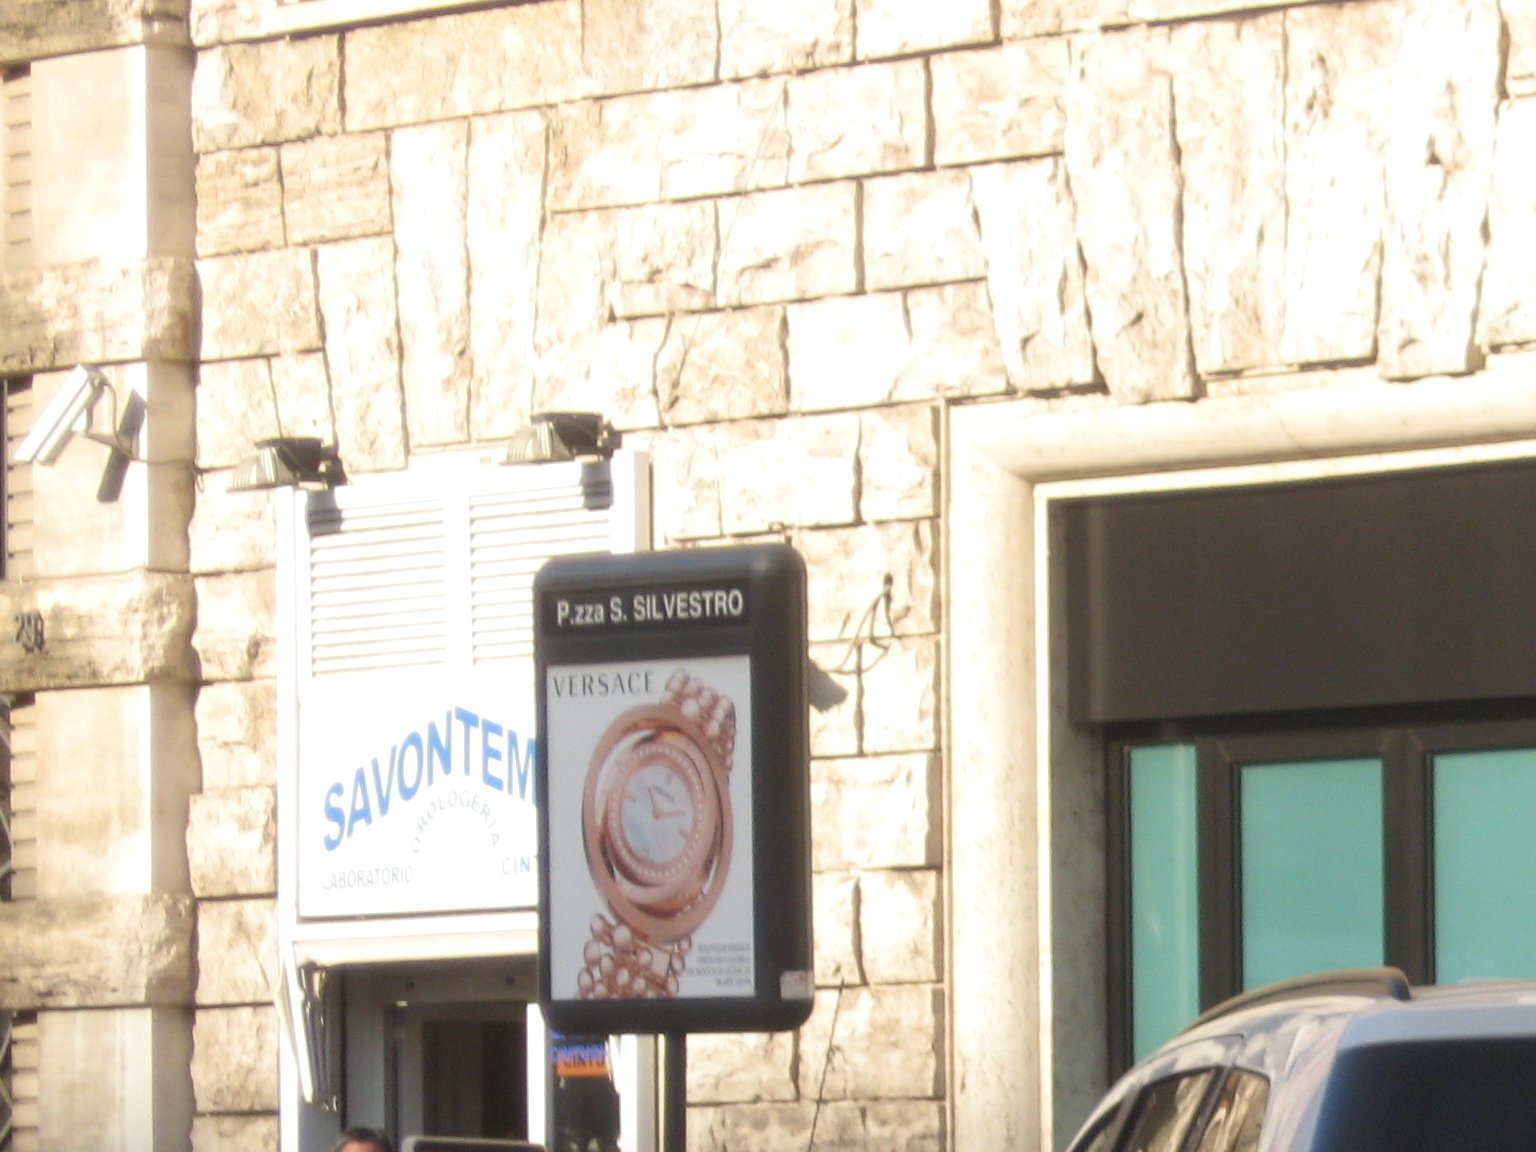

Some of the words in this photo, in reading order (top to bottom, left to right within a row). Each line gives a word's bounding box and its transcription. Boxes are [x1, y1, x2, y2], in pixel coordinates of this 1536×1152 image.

[556, 600, 605, 627] P.zza
[610, 595, 628, 623] S.
[632, 588, 744, 622] SILVESTRO
[553, 671, 657, 698] VERSACE
[411, 789, 501, 855] OROLOGERIA
[322, 864, 414, 891] LABORATORIO
